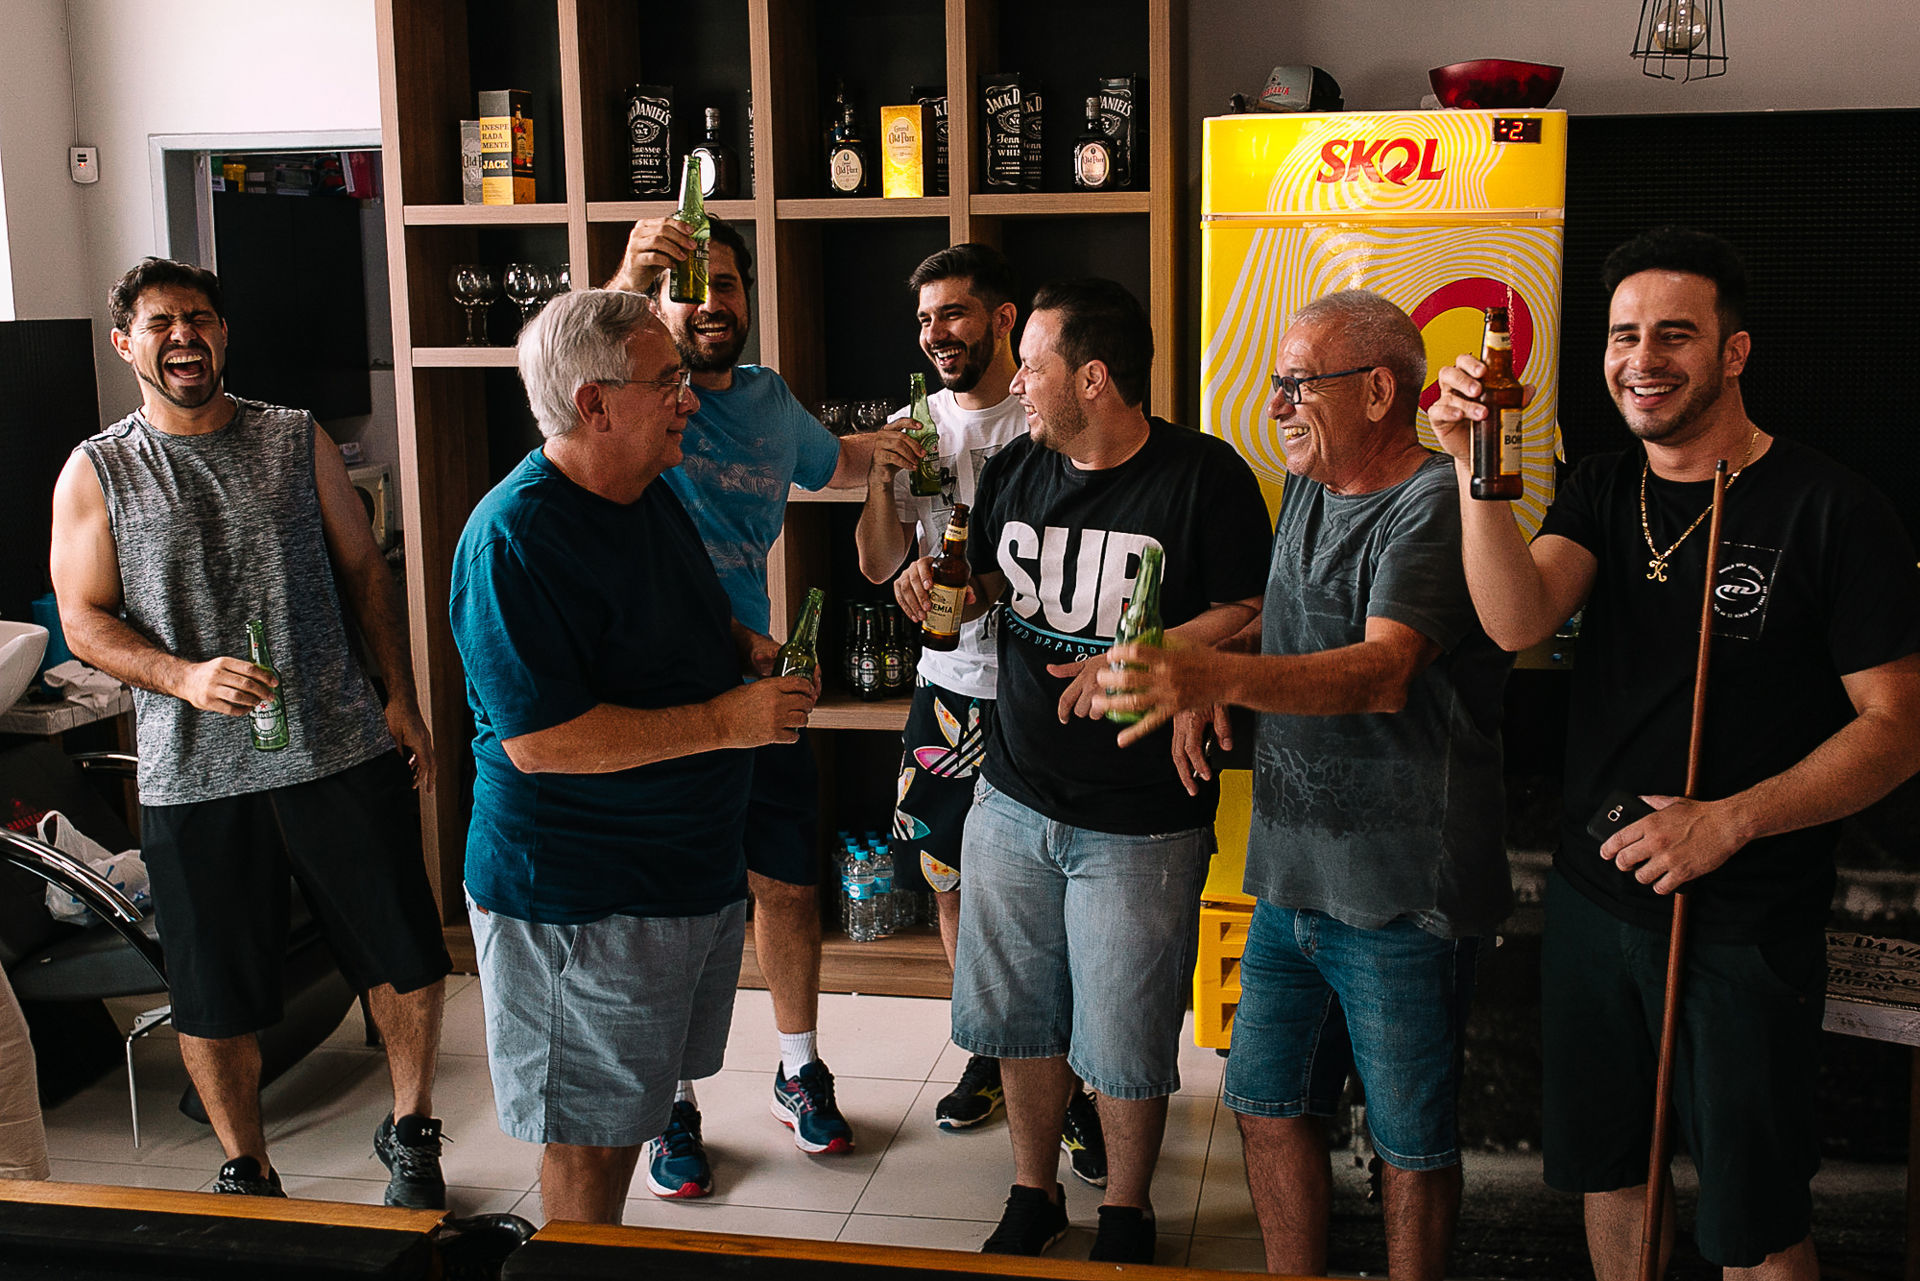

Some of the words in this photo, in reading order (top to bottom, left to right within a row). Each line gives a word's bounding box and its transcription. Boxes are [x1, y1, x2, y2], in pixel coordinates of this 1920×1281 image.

[986, 93, 1013, 115] JACK
[481, 123, 509, 131] INESPE
[888, 132, 900, 144] Old
[482, 160, 509, 170] JACK
[1316, 137, 1447, 186] SKOL
[997, 521, 1166, 638] SUP
